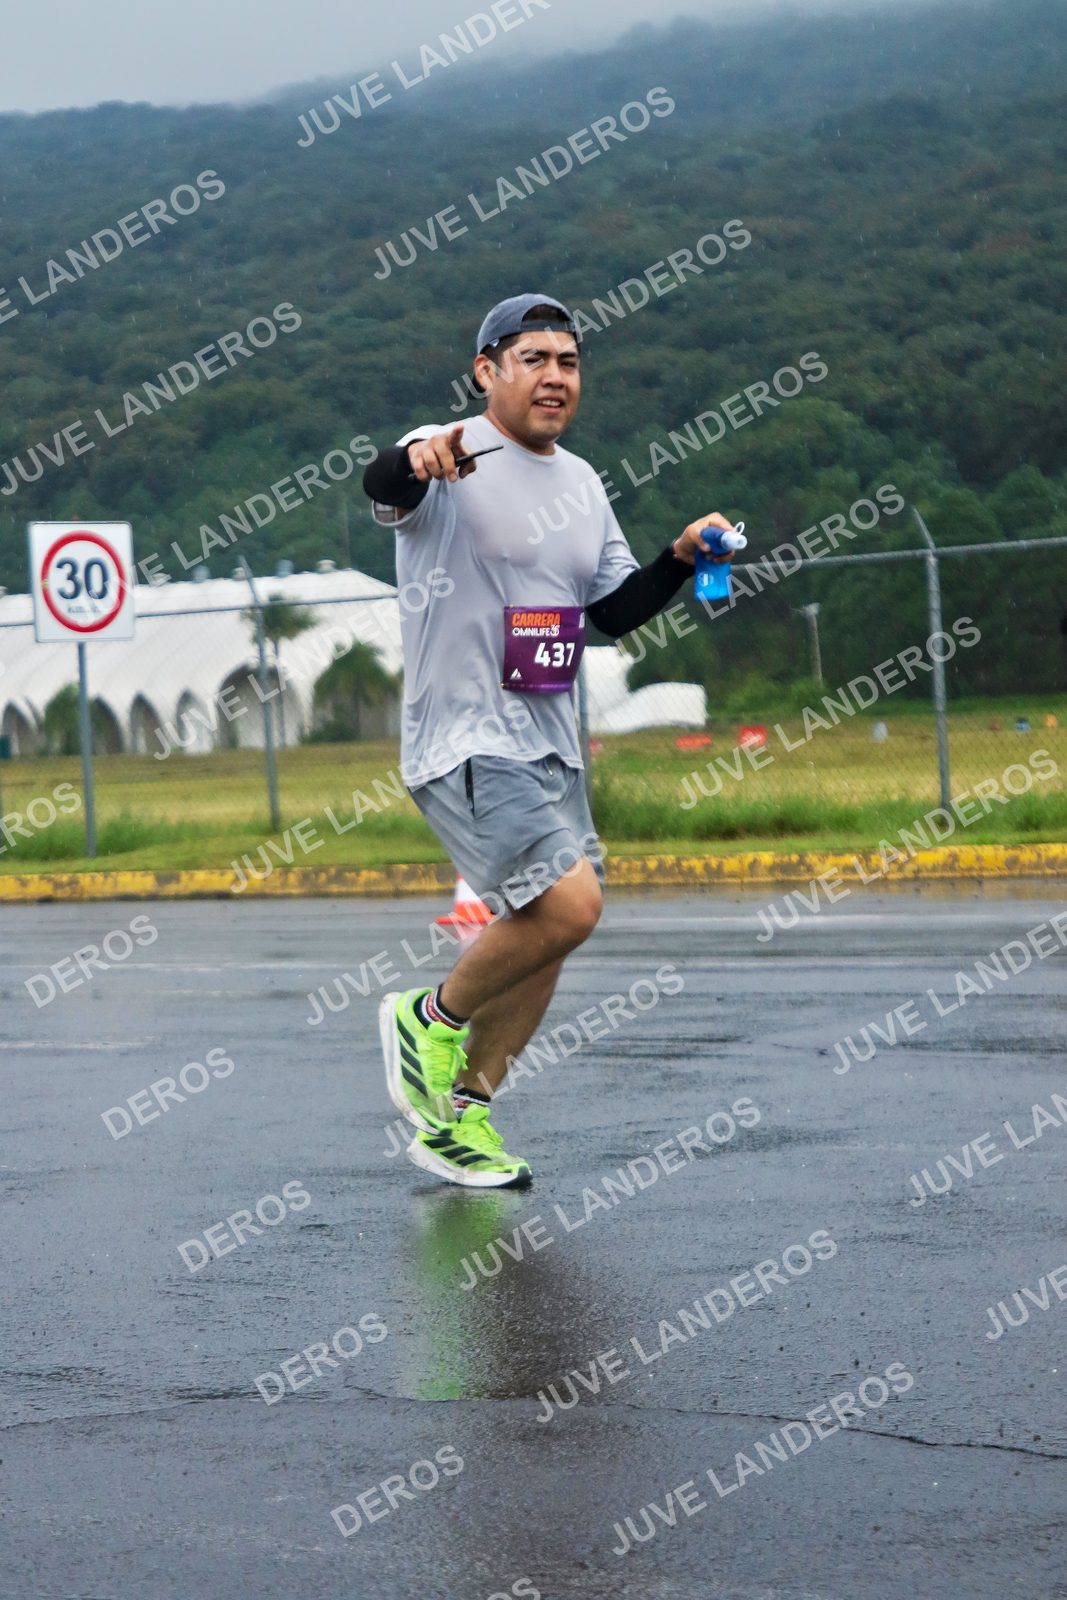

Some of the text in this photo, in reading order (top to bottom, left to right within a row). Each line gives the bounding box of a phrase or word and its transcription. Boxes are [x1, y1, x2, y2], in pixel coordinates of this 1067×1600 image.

[56, 556, 109, 599] 30
[512, 612, 560, 626] CARRERA
[534, 642, 575, 667] 437
